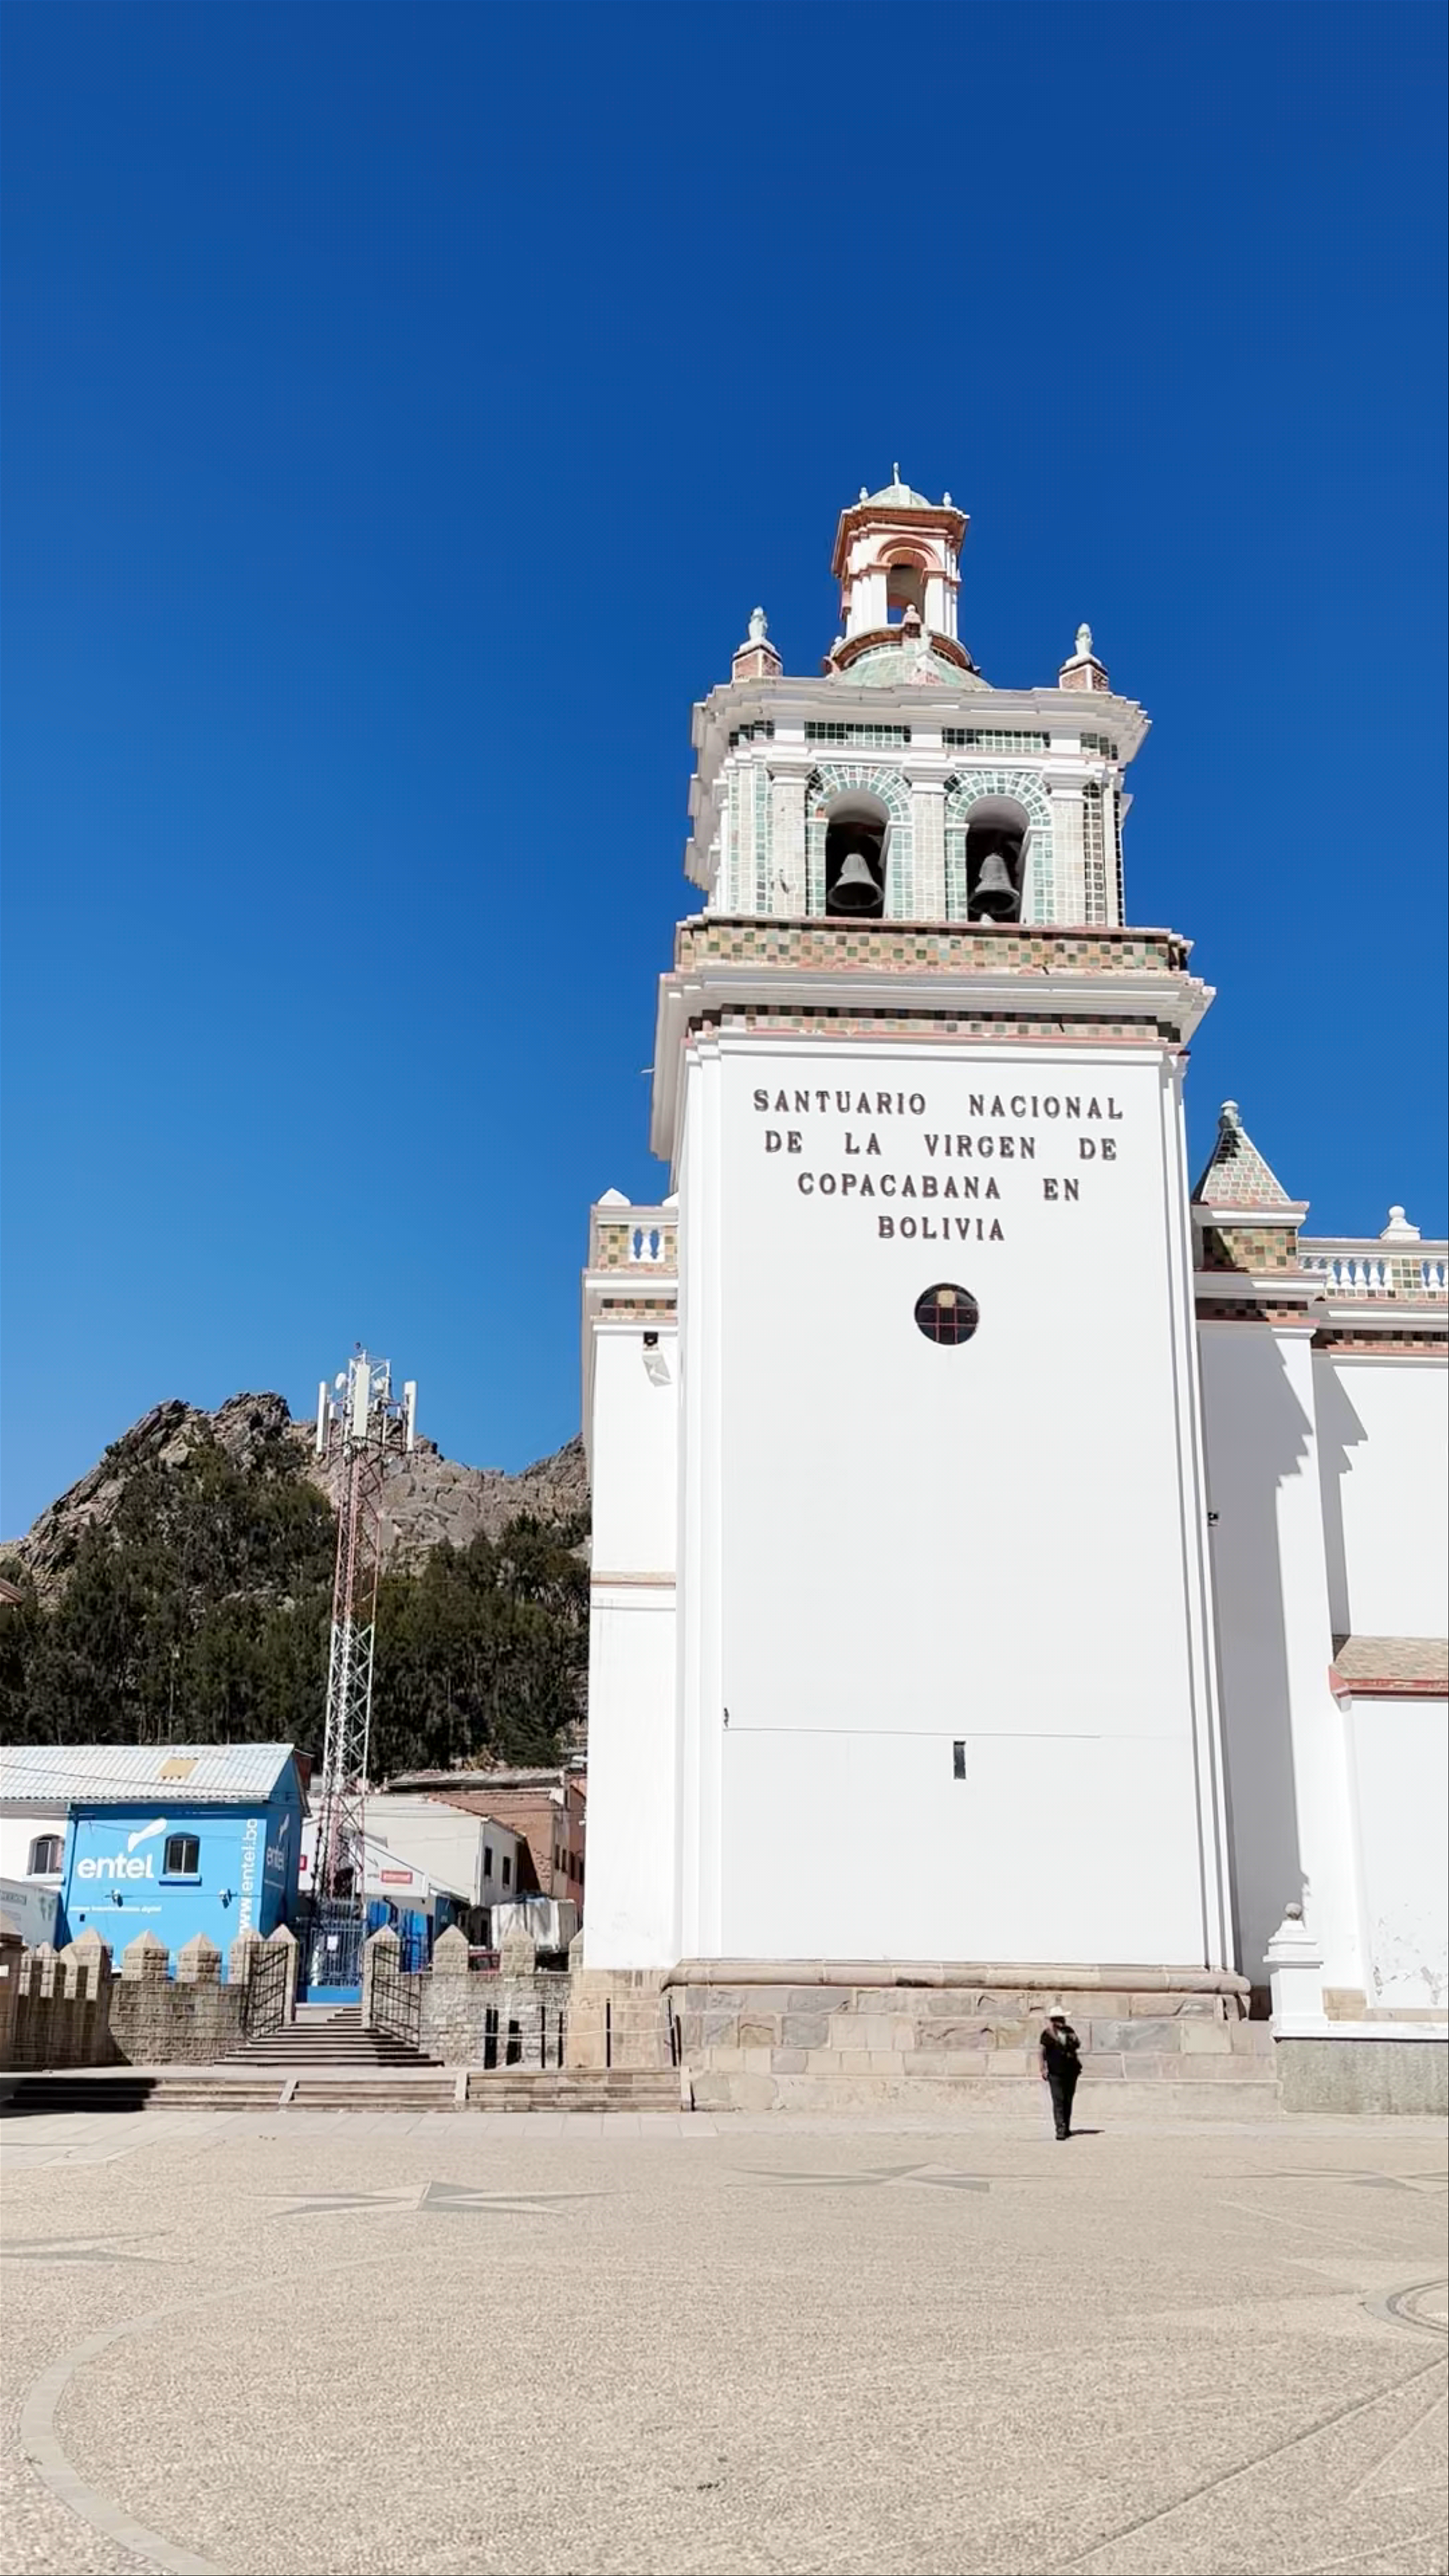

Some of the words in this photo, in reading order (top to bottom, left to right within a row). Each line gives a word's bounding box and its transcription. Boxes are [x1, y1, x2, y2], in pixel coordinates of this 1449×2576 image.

[753, 1089, 926, 1115] SANTUARIO
[969, 1094, 1123, 1120] NACIONAL
[765, 1130, 803, 1154] DE
[844, 1132, 881, 1155] LA
[923, 1133, 1035, 1159] VIRGEN
[1079, 1137, 1117, 1161] DE
[797, 1172, 1001, 1200] COPACABANA
[1042, 1178, 1079, 1201] EN
[878, 1215, 1004, 1241] BOLIVIA
[77, 1853, 154, 1878] entel
